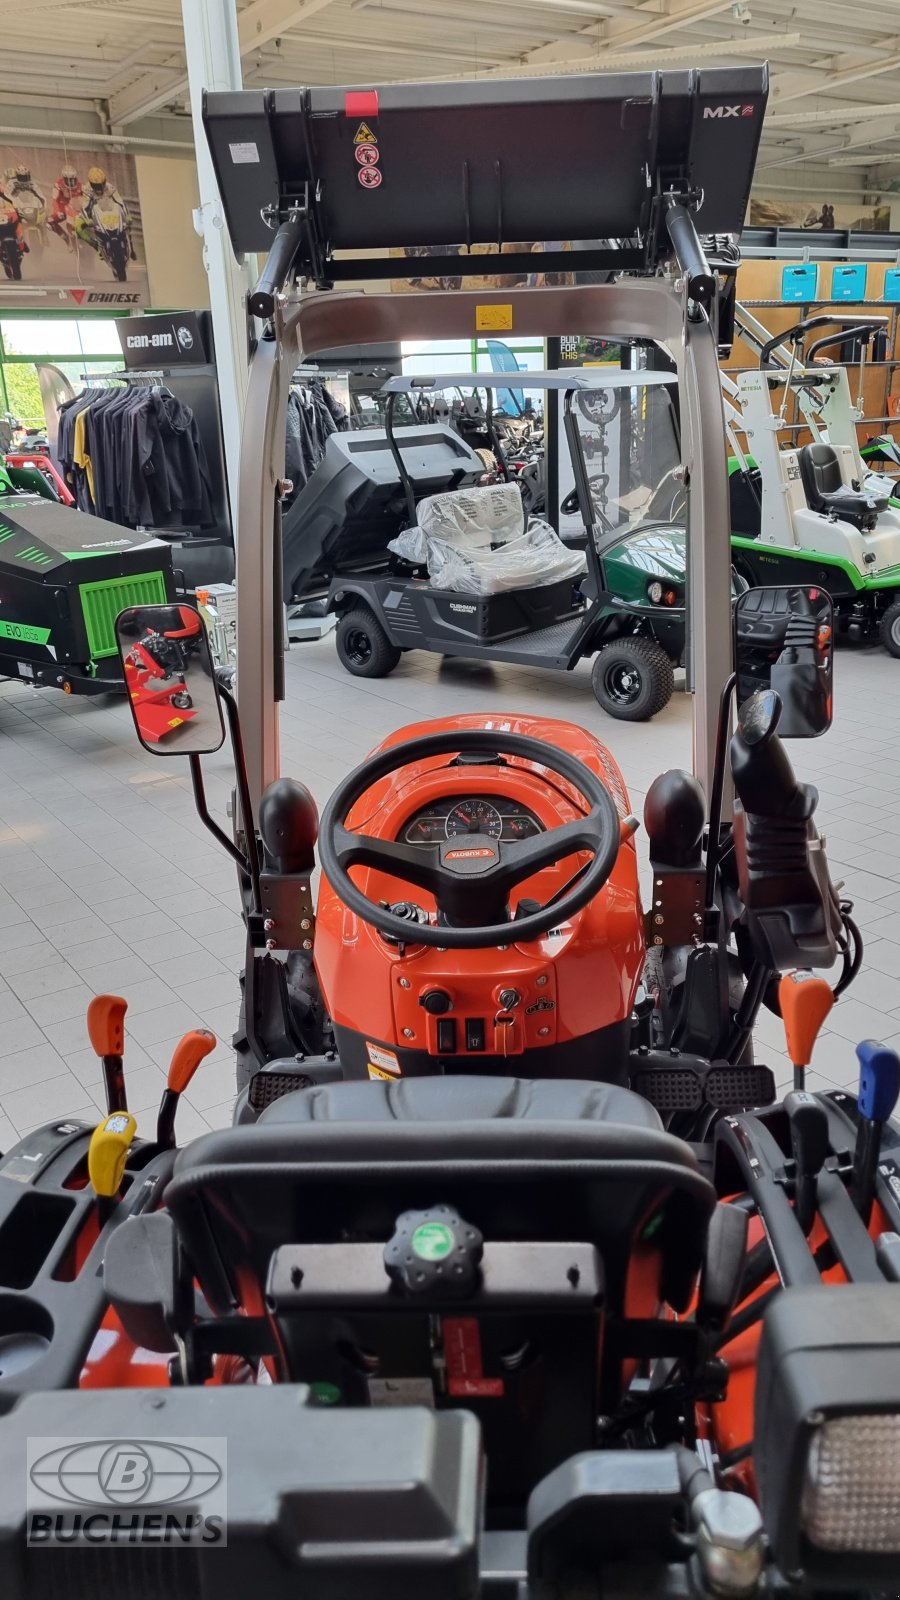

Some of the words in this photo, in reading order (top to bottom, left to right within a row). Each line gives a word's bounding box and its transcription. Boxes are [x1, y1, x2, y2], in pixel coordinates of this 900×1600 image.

[703, 105, 741, 119] MX
[127, 332, 173, 348] can-am
[560, 335, 580, 344] BUILT
[560, 344, 576, 352] FOR
[560, 352, 578, 360] THIS
[6, 624, 21, 637] EVO
